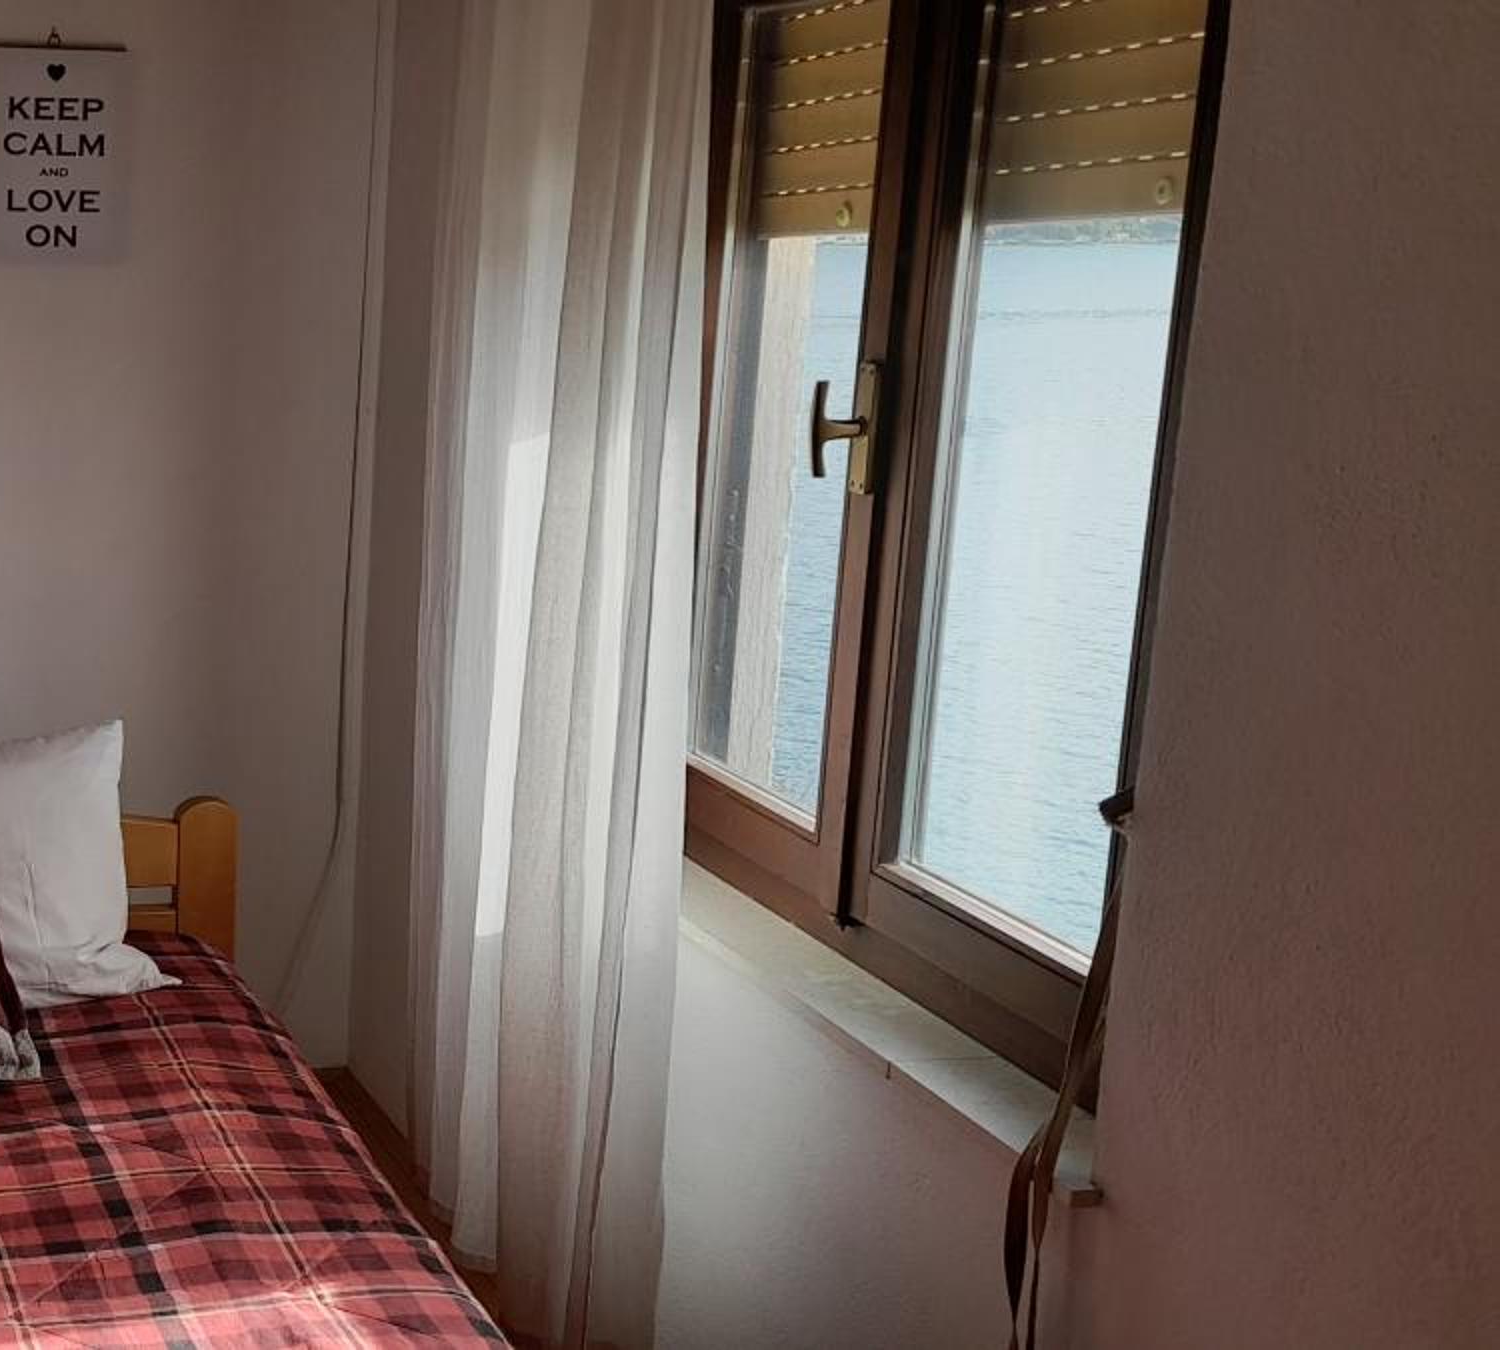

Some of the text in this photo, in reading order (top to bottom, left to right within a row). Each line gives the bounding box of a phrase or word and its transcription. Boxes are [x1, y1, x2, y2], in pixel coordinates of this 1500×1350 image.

[8, 96, 104, 121] KEEP
[3, 132, 105, 156] CALM
[39, 168, 69, 177] AND
[6, 189, 101, 213] LOVE
[25, 224, 78, 248] ON
